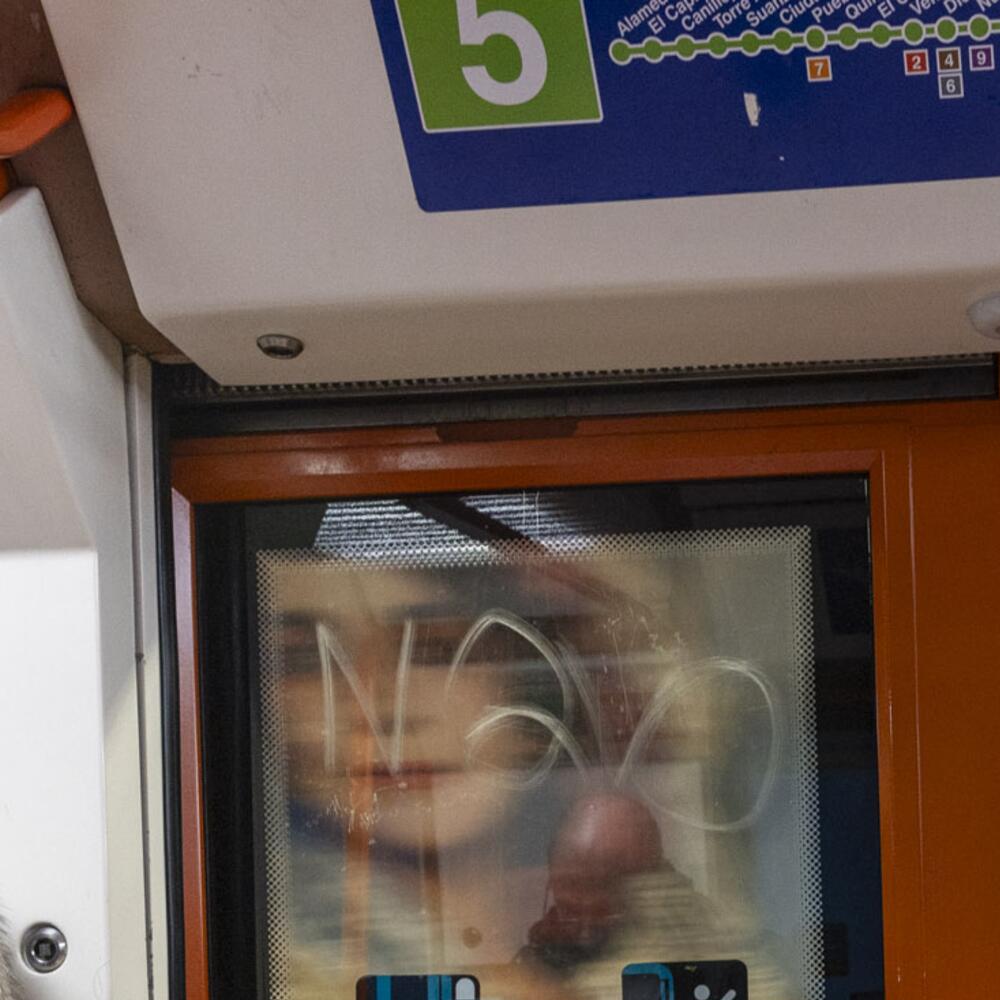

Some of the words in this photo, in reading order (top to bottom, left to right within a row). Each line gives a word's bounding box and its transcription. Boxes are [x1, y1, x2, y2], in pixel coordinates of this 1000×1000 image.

[648, 14, 667, 35] El
[664, 0, 700, 21] Cap
[746, 0, 789, 28] Suan
[811, 0, 849, 23] Pue
[456, 0, 548, 106] 5
[944, 53, 954, 67] 4
[976, 50, 986, 66] 9
[814, 61, 824, 77] 7
[911, 55, 922, 70] 2
[946, 78, 956, 94] 6
